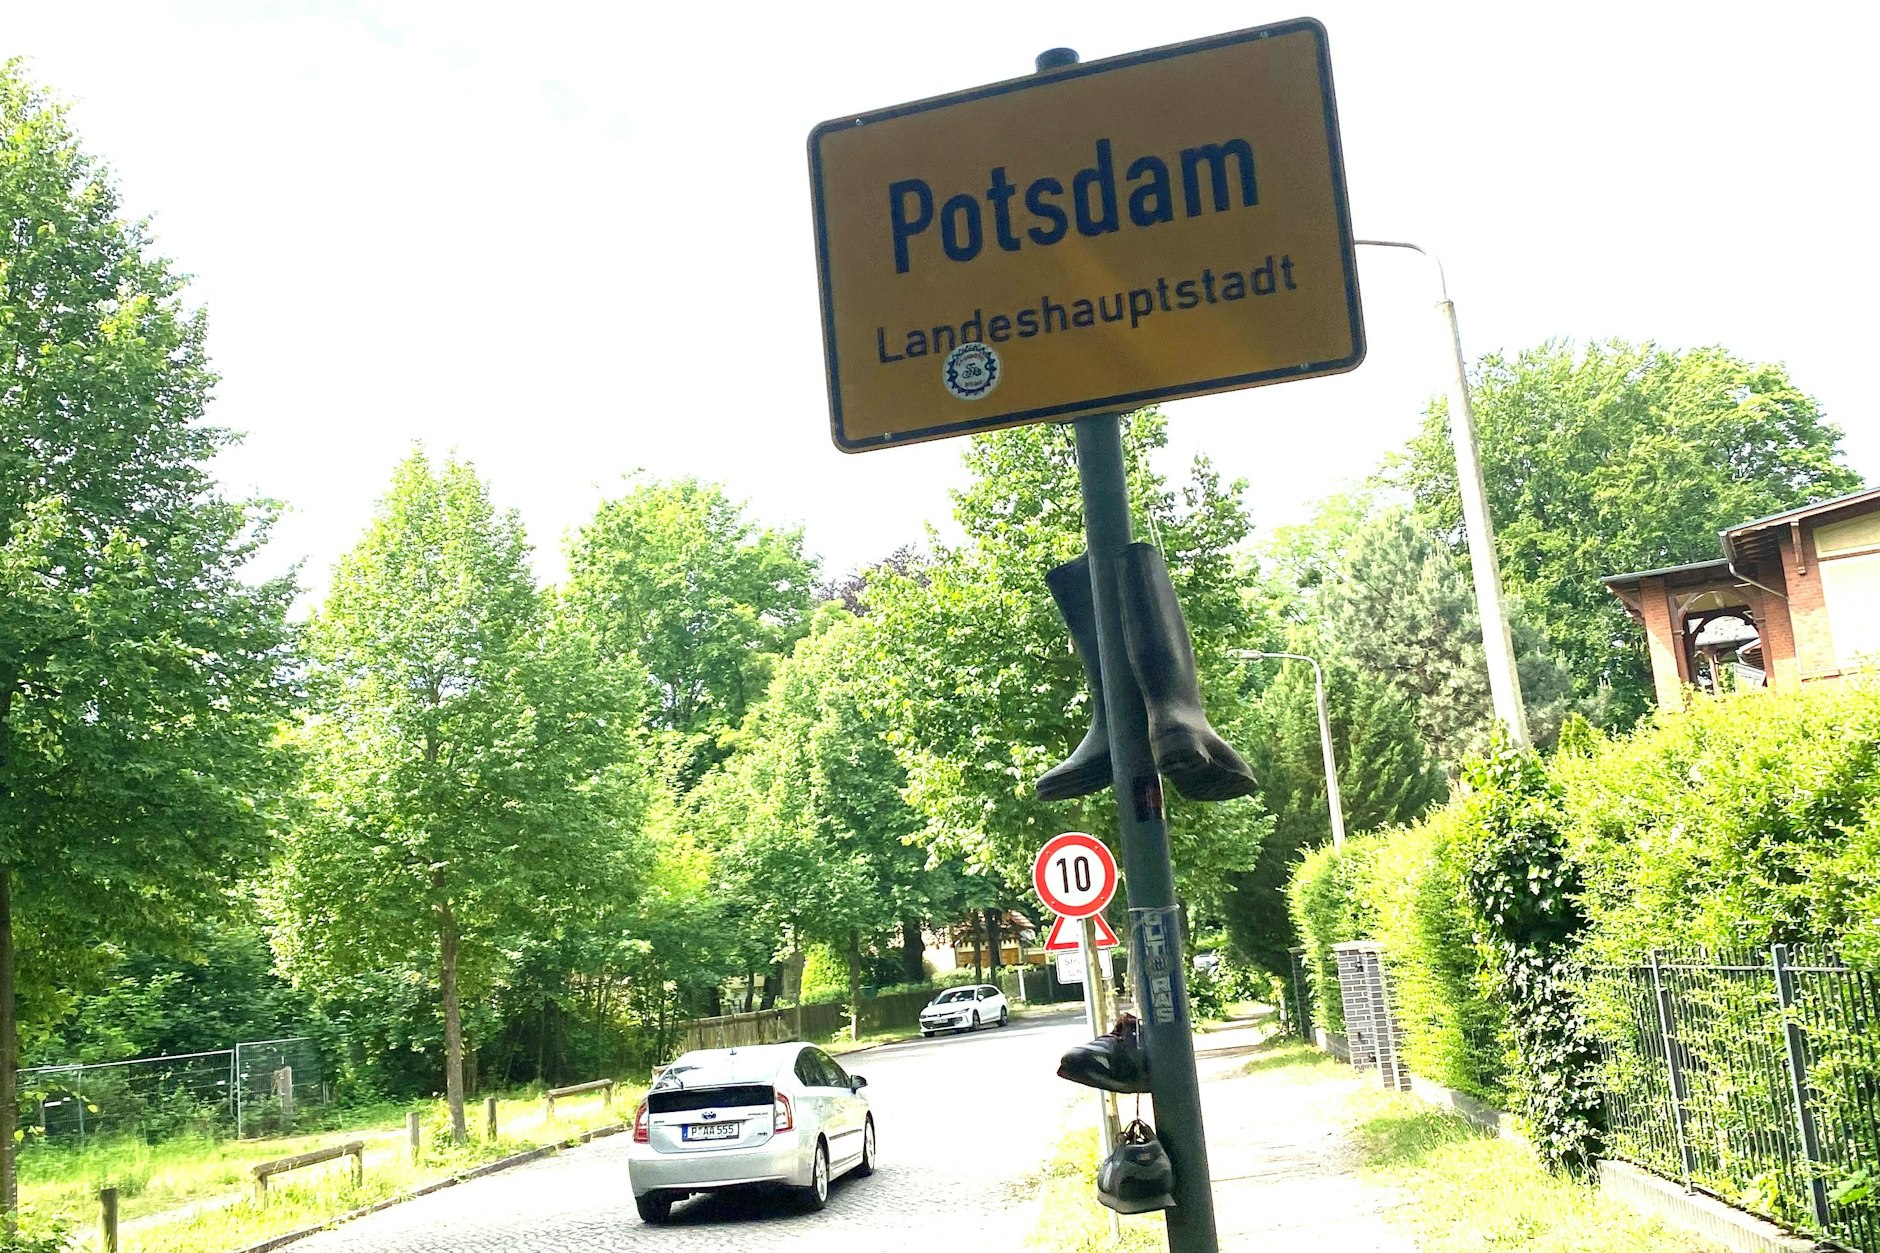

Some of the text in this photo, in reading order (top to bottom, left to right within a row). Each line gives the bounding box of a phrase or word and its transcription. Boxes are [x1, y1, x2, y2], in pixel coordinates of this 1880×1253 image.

[889, 138, 1259, 274] Potsdam
[876, 255, 1298, 364] Landeshauptstadt
[1056, 856, 1091, 894] 10
